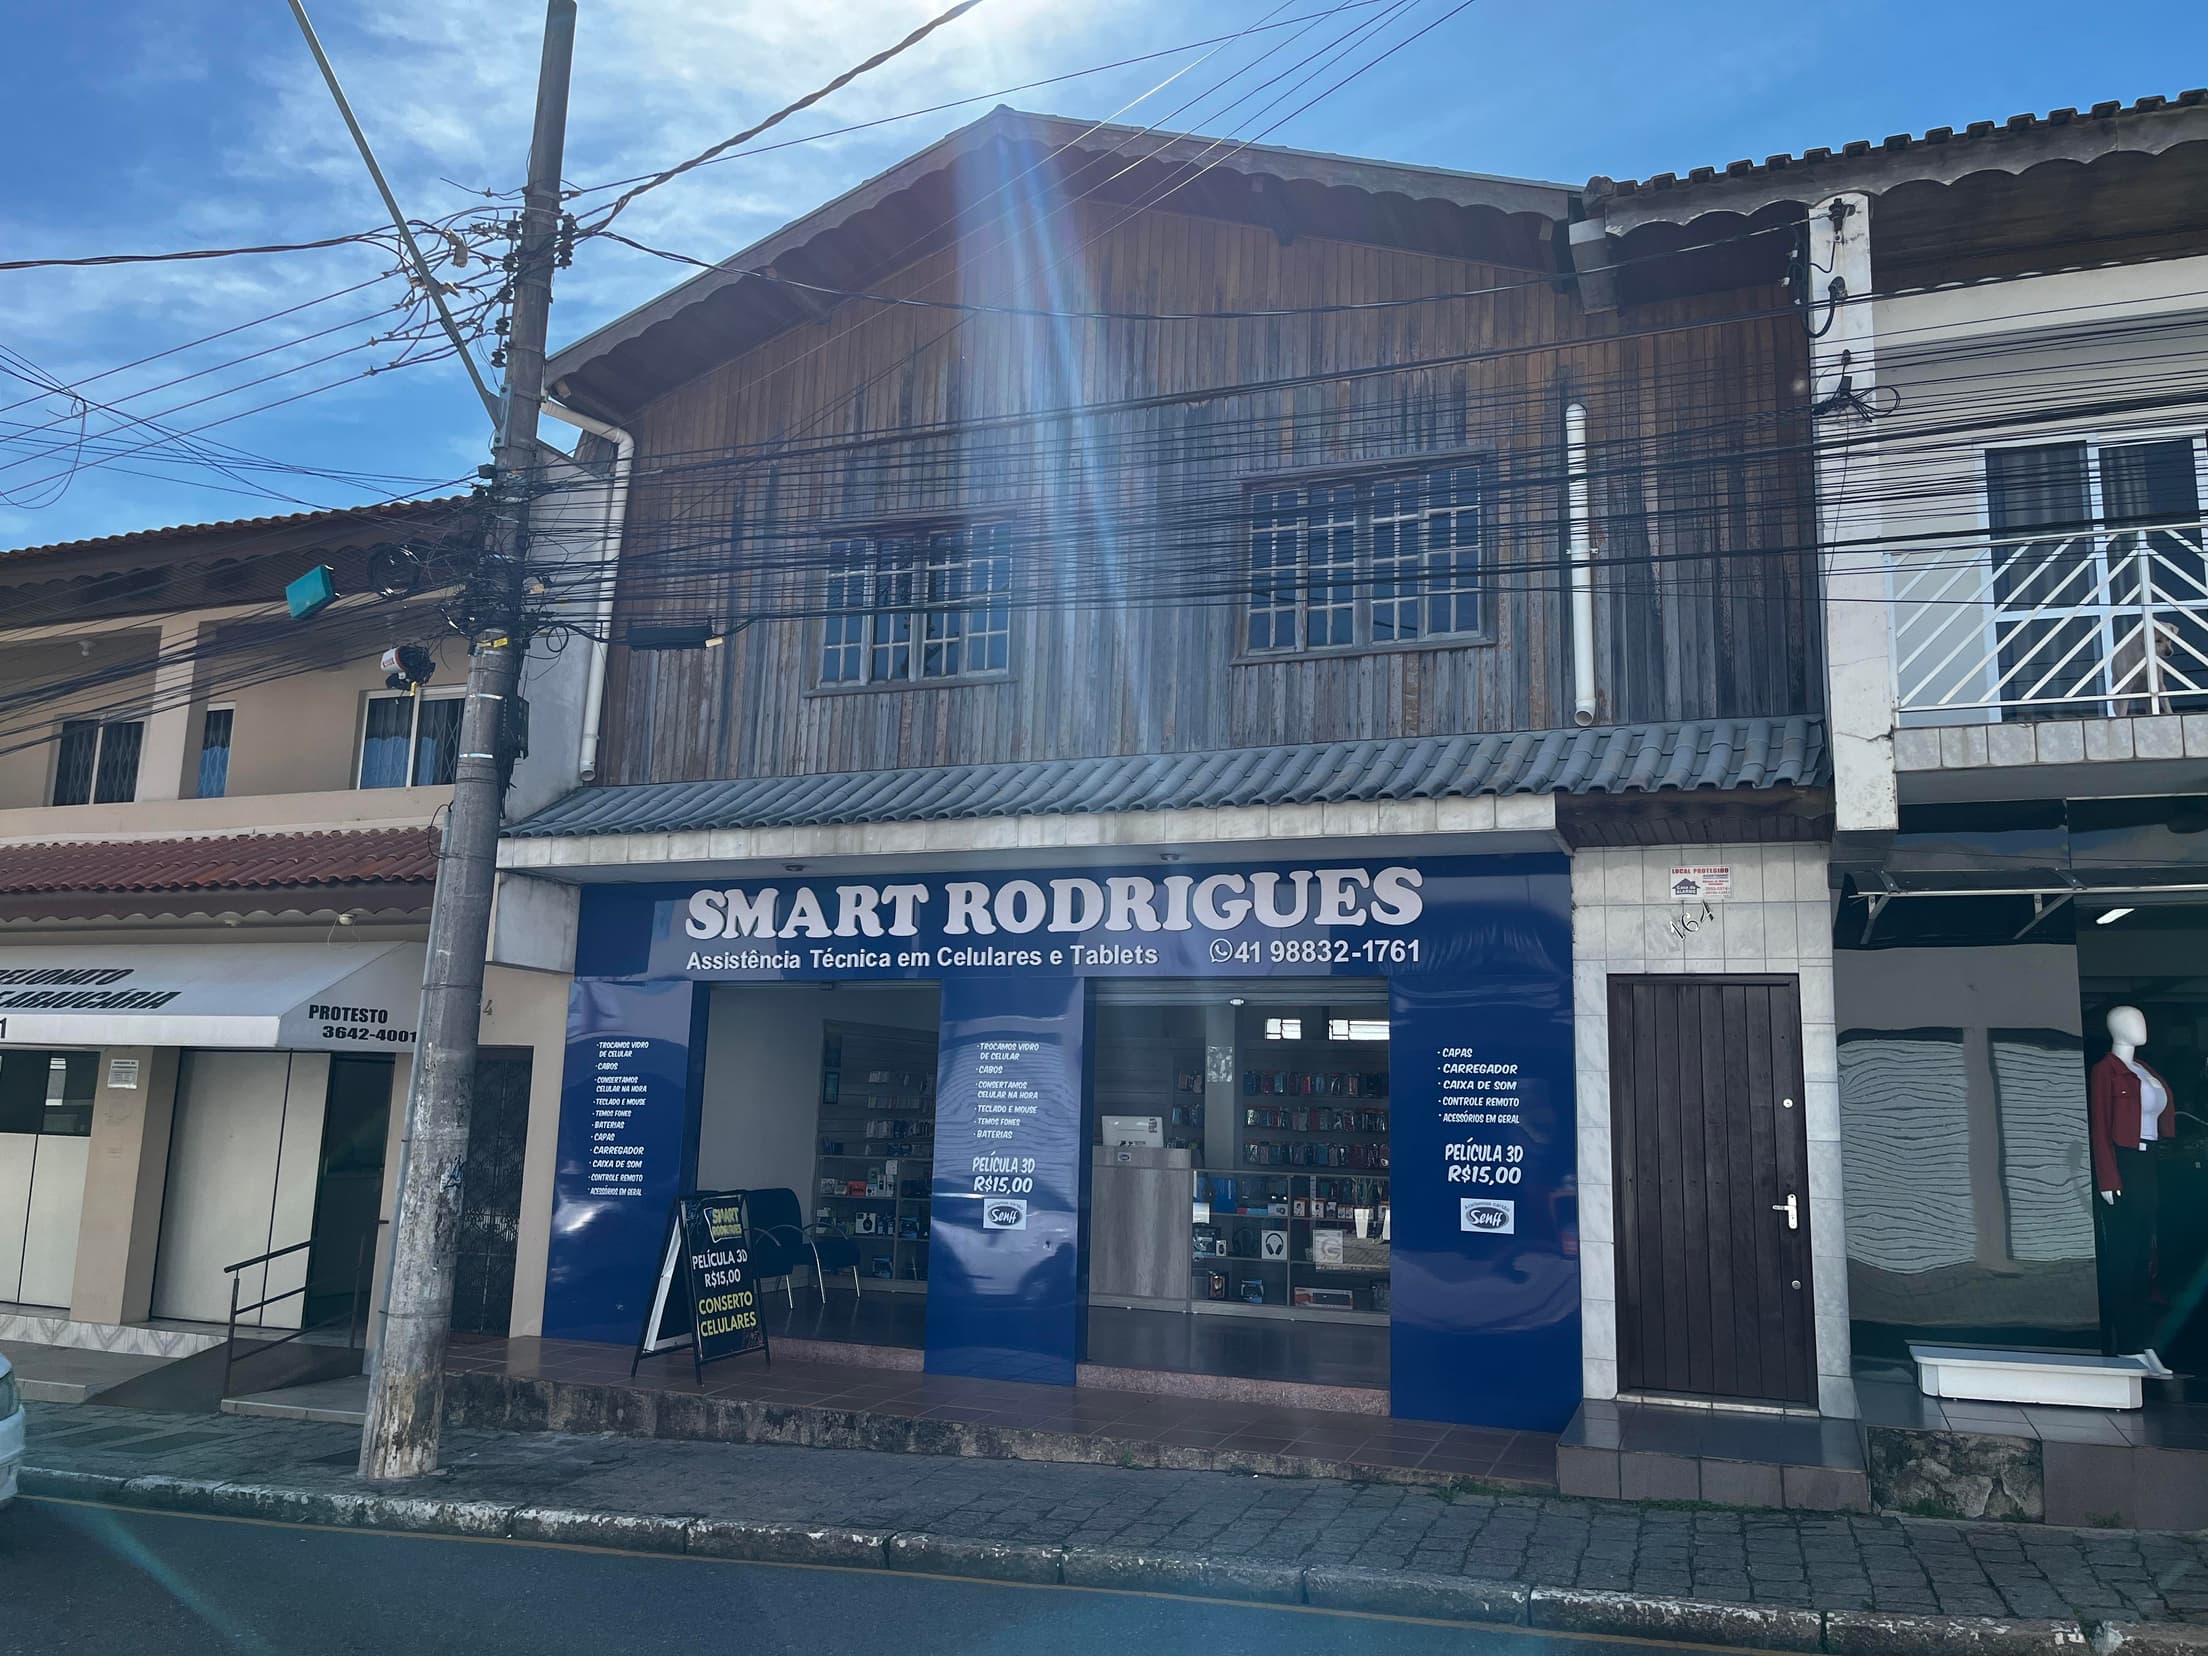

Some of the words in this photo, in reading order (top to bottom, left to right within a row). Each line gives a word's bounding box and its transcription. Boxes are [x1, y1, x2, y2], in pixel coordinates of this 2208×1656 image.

[685, 883, 930, 940] SMART
[943, 866, 1424, 936] RODRIGUES
[1670, 900, 1714, 941] 164
[686, 948, 801, 971] Assistência
[810, 946, 892, 970] Técnica
[897, 950, 931, 968] em
[937, 945, 1043, 968] Celulares
[1049, 949, 1064, 966] e
[1070, 943, 1159, 966] Tablets
[1233, 940, 1261, 964] 41
[1270, 939, 1421, 963] 98832-1761
[308, 1004, 389, 1024] PROTESTO
[322, 1025, 417, 1043] 3642-4001
[598, 1041, 630, 1049] TROCAMOS
[631, 1041, 649, 1049] VIDRO
[979, 1043, 1017, 1051] TROCAMOS
[1018, 1043, 1040, 1051] VIDRO
[599, 1050, 607, 1058] DE
[608, 1050, 633, 1058] CELULAR
[980, 1052, 990, 1060] DE
[990, 1052, 1020, 1060] CELULAR
[1442, 1047, 1473, 1058] CAPAS
[597, 1062, 619, 1070] CABOS
[978, 1065, 1003, 1074] CABOS
[1442, 1063, 1518, 1075] CARREGADOR
[596, 1076, 639, 1084] CONSERTAMOS
[978, 1080, 1028, 1089] CONSERTAMOS
[1442, 1080, 1474, 1090] CAIXA
[1477, 1080, 1491, 1090] DE
[1493, 1080, 1518, 1091] SOM
[596, 1085, 620, 1093] CELULAR
[621, 1085, 630, 1093] NA
[630, 1085, 648, 1093] HORA
[977, 1090, 1006, 1099] CELULAR
[1008, 1091, 1018, 1099] NA
[1019, 1091, 1039, 1100] HORA
[596, 1098, 620, 1106] TECLADO
[626, 1098, 646, 1106] MOUSE
[1442, 1096, 1484, 1107] CONTROLE
[1485, 1097, 1520, 1107] REMOTO
[977, 1105, 1007, 1113] TECLADO
[1009, 1105, 1013, 1113] E
[1014, 1105, 1038, 1114] MOUSE
[977, 1118, 999, 1126] TEMOS
[1000, 1118, 1021, 1126] FONES
[1442, 1111, 1484, 1123] ACESSÓRIOS
[1485, 1114, 1496, 1124] EM
[1497, 1114, 1520, 1124] GERAL
[594, 1121, 625, 1129] BATERIAS
[593, 1132, 616, 1141] CAPAS
[976, 1130, 1013, 1139] BATERIAS
[592, 1146, 645, 1155] CARREGADOR
[1445, 1137, 1502, 1162] PELÍCULA
[1505, 1145, 1524, 1163] 3D
[592, 1160, 614, 1168] CAIXA
[615, 1160, 625, 1168] DE
[626, 1160, 643, 1168] SOM
[972, 1150, 1018, 1174] PELÍCULA
[1021, 1157, 1036, 1174] 3D
[590, 1173, 619, 1182] CONTROLE
[620, 1173, 644, 1182] REMOTO
[1447, 1164, 1522, 1186] R$15,00
[973, 1175, 1033, 1195] R$15,00
[712, 1207, 740, 1224] SMART
[991, 1208, 1018, 1224] Senff
[1470, 1209, 1504, 1227] Senff
[692, 1249, 735, 1270] PELÍCULA
[736, 1248, 748, 1263] 3D
[704, 1269, 741, 1289] R$15,00
[698, 1291, 753, 1316] CONSERTO
[700, 1311, 757, 1338] CELULARES
